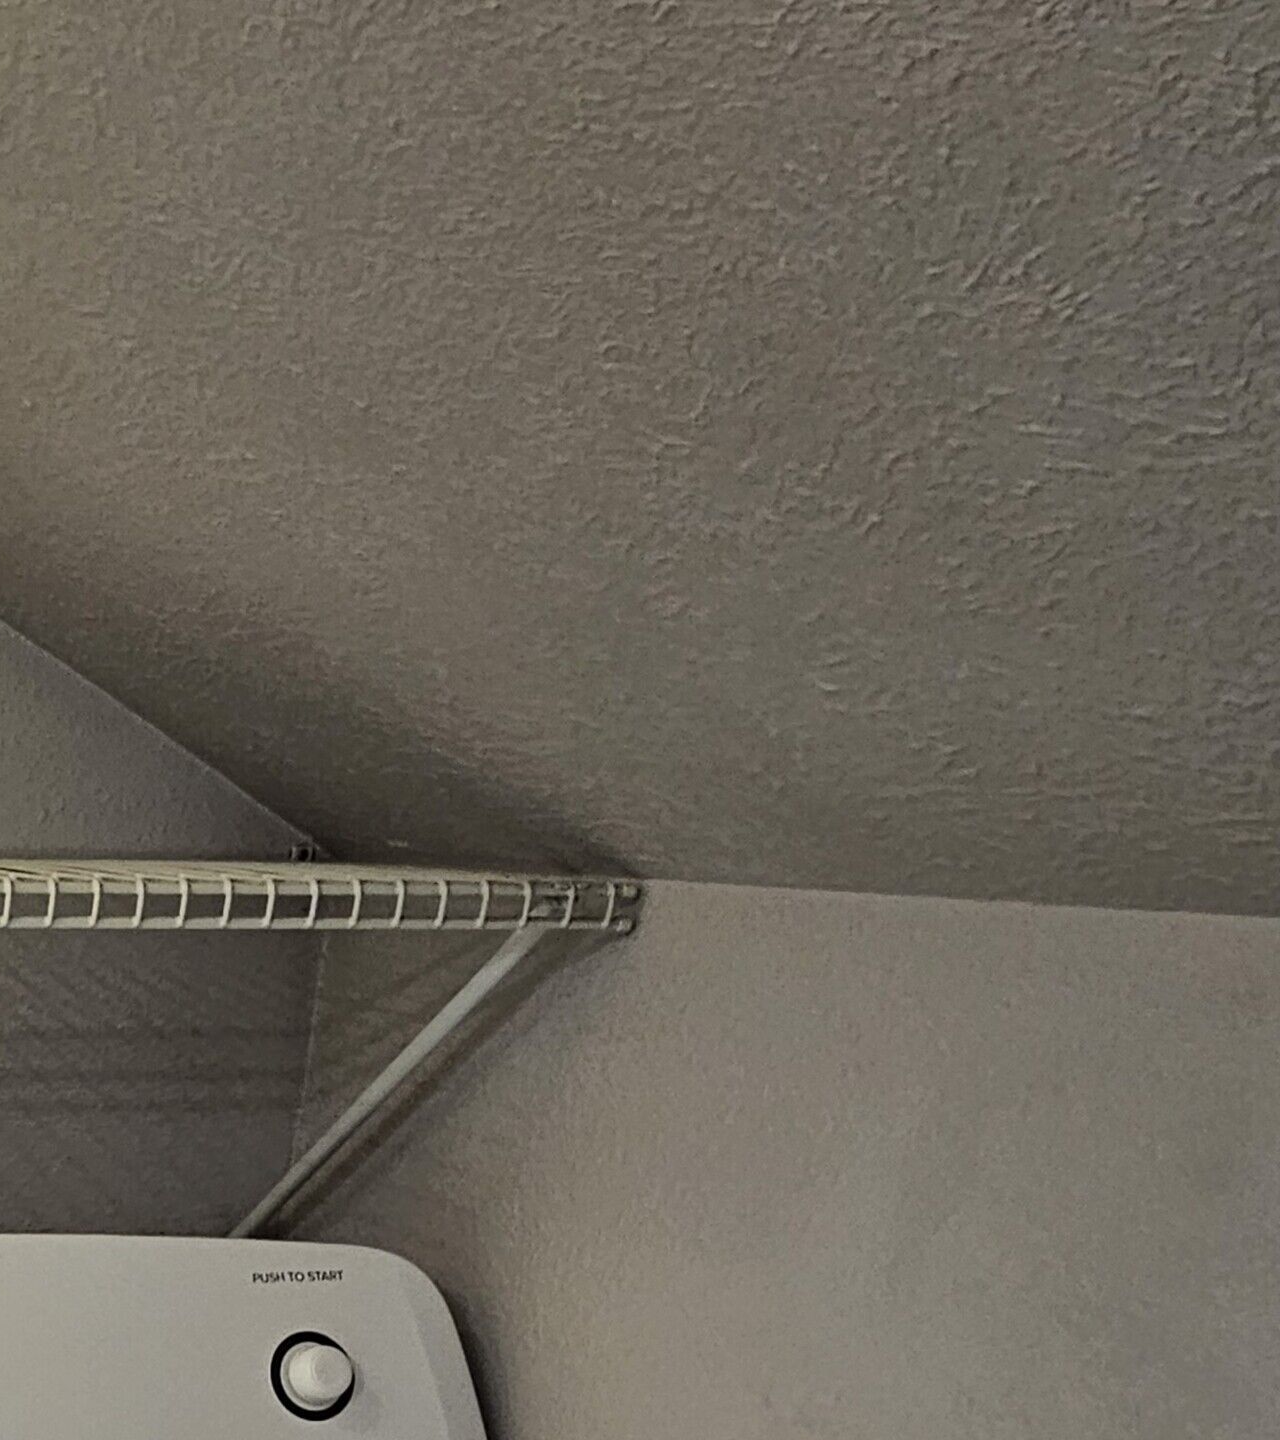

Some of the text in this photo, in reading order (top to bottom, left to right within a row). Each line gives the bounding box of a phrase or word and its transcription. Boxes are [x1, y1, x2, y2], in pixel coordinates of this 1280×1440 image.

[252, 1270, 343, 1284] PUSH TO START
